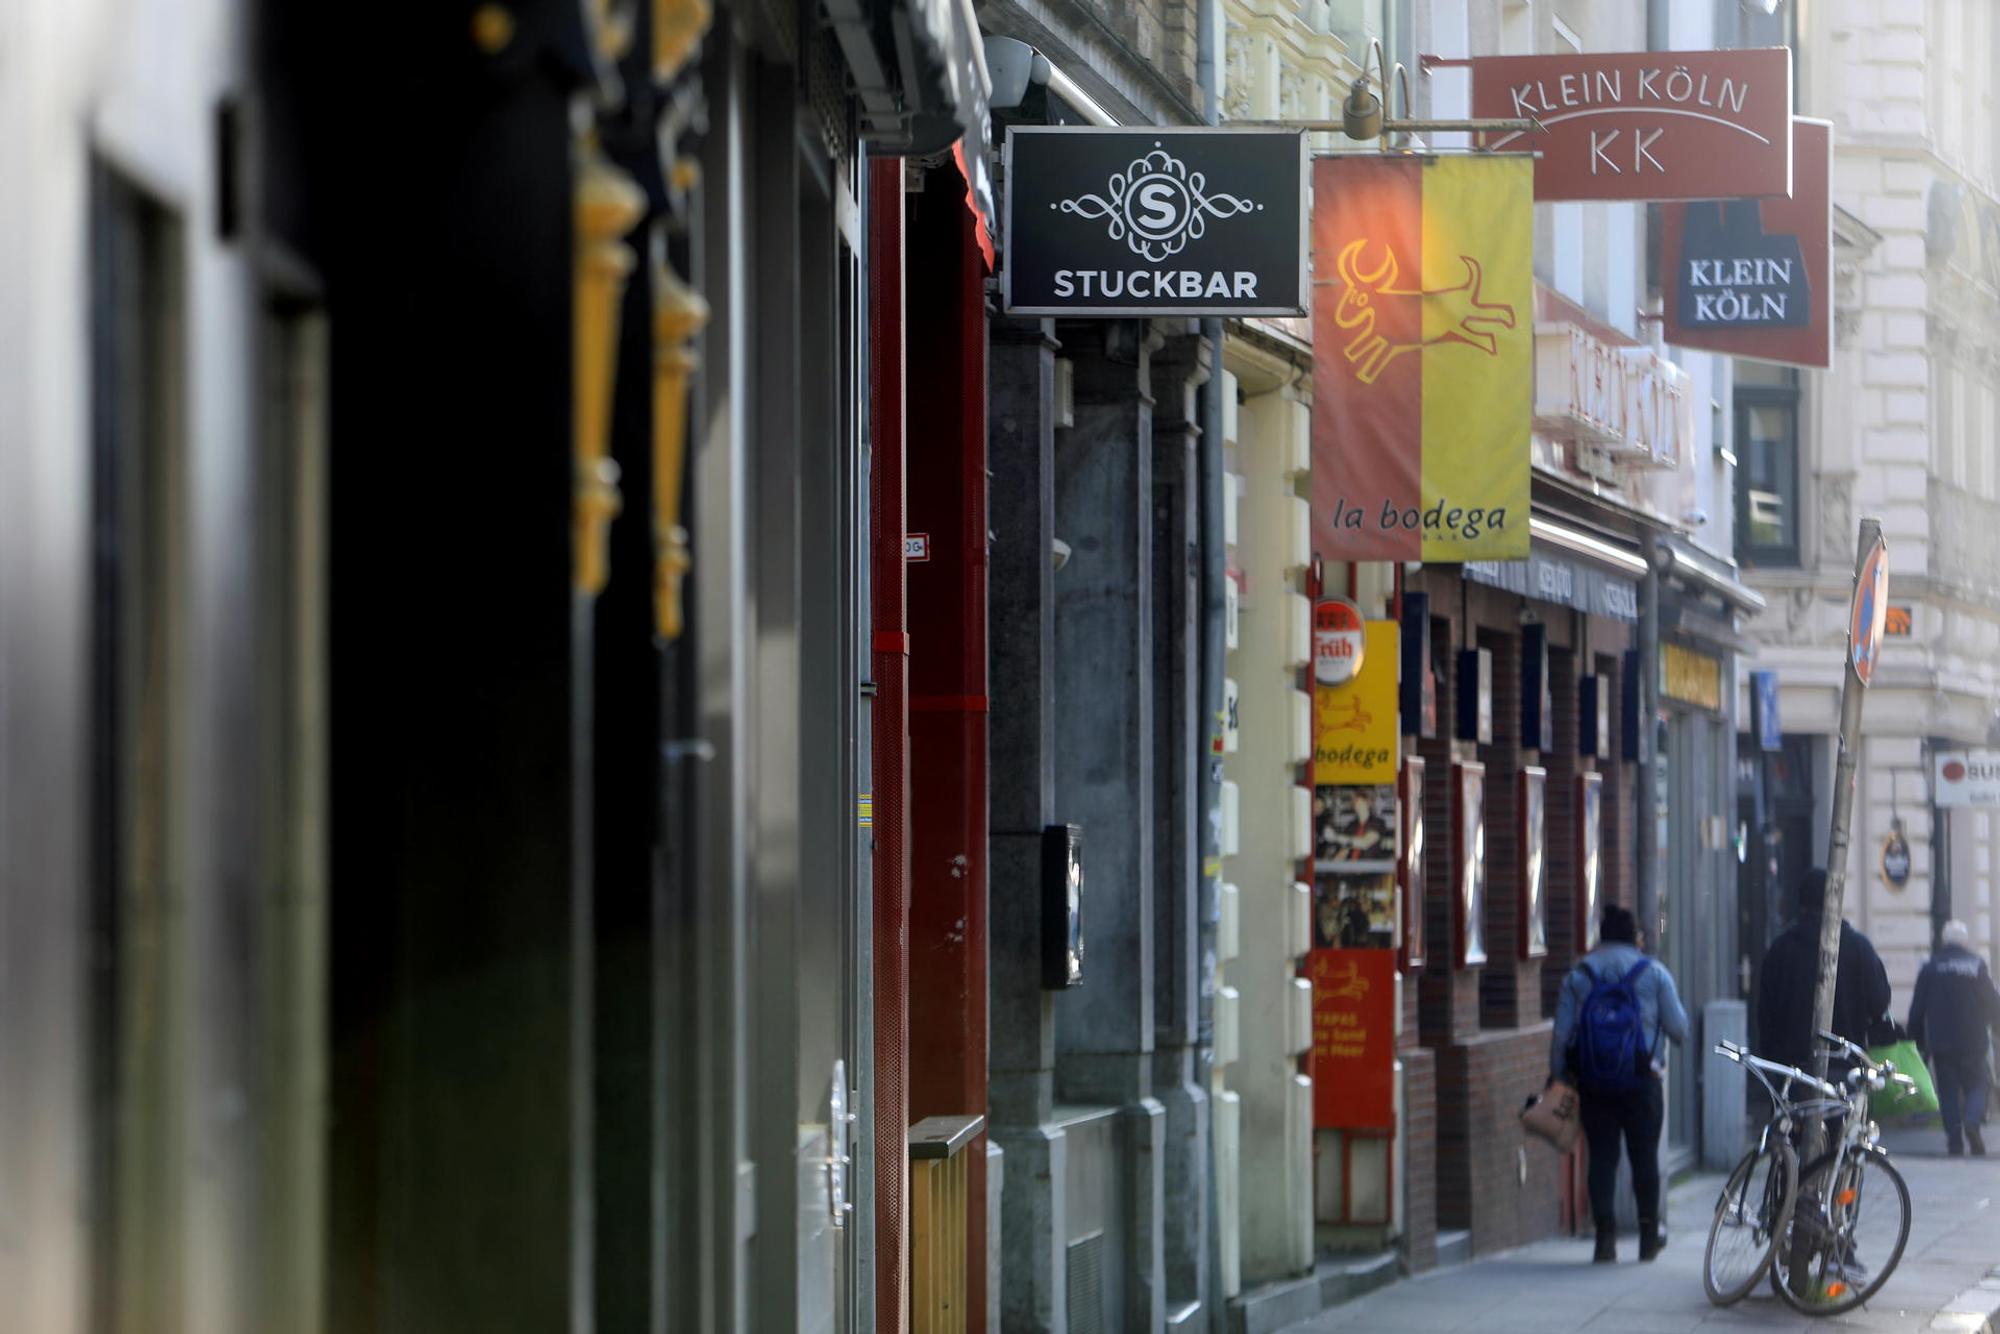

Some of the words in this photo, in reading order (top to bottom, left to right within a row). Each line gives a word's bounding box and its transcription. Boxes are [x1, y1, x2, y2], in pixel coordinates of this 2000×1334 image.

[1510, 69, 1622, 118] KLEIN
[1637, 65, 1749, 114] KÖLN
[1590, 128, 1622, 175] K
[1634, 127, 1666, 174] K
[1137, 183, 1177, 229] S
[1053, 269, 1258, 298] STUCKBAR
[1688, 257, 1794, 287] KLEIN
[1693, 287, 1788, 321] KÖLN
[1333, 498, 1364, 529] la
[1380, 499, 1507, 540] bodega
